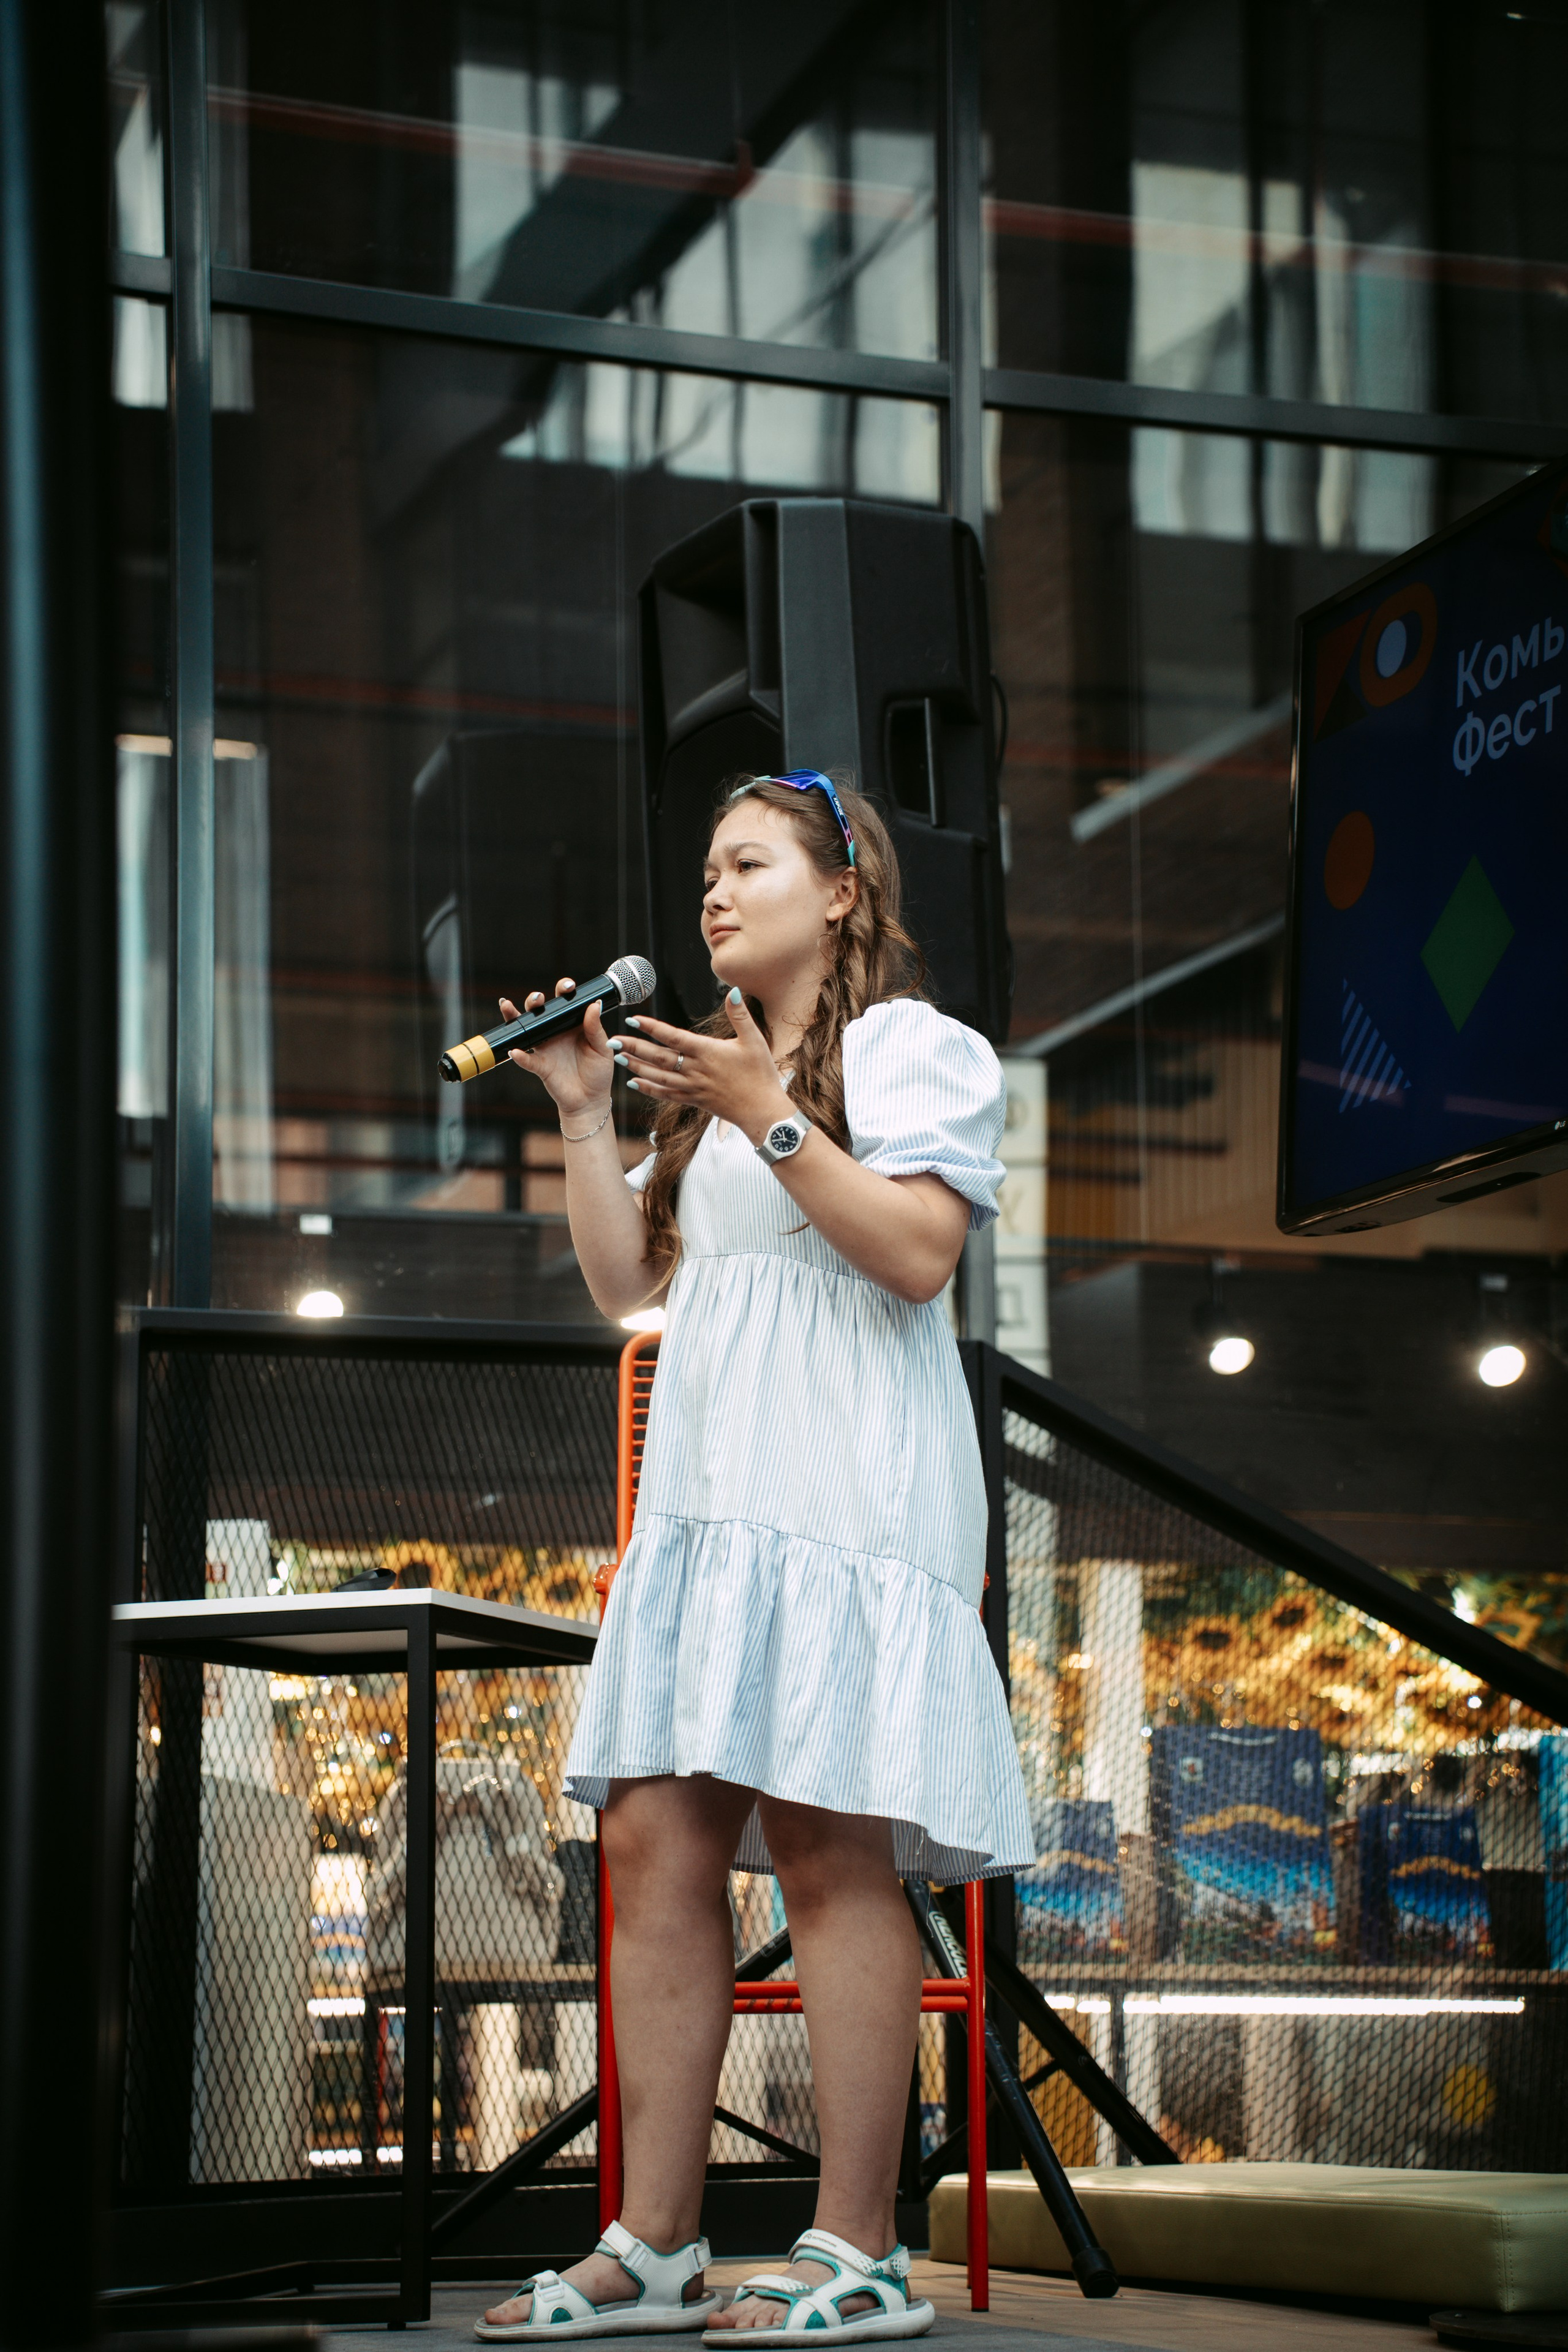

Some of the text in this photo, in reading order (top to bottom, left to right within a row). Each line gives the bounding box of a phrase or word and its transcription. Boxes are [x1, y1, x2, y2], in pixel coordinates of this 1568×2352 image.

[1456, 616, 1567, 708] Комь
[1452, 684, 1562, 777] Фест
[933, 1915, 968, 1978] HERCULE
